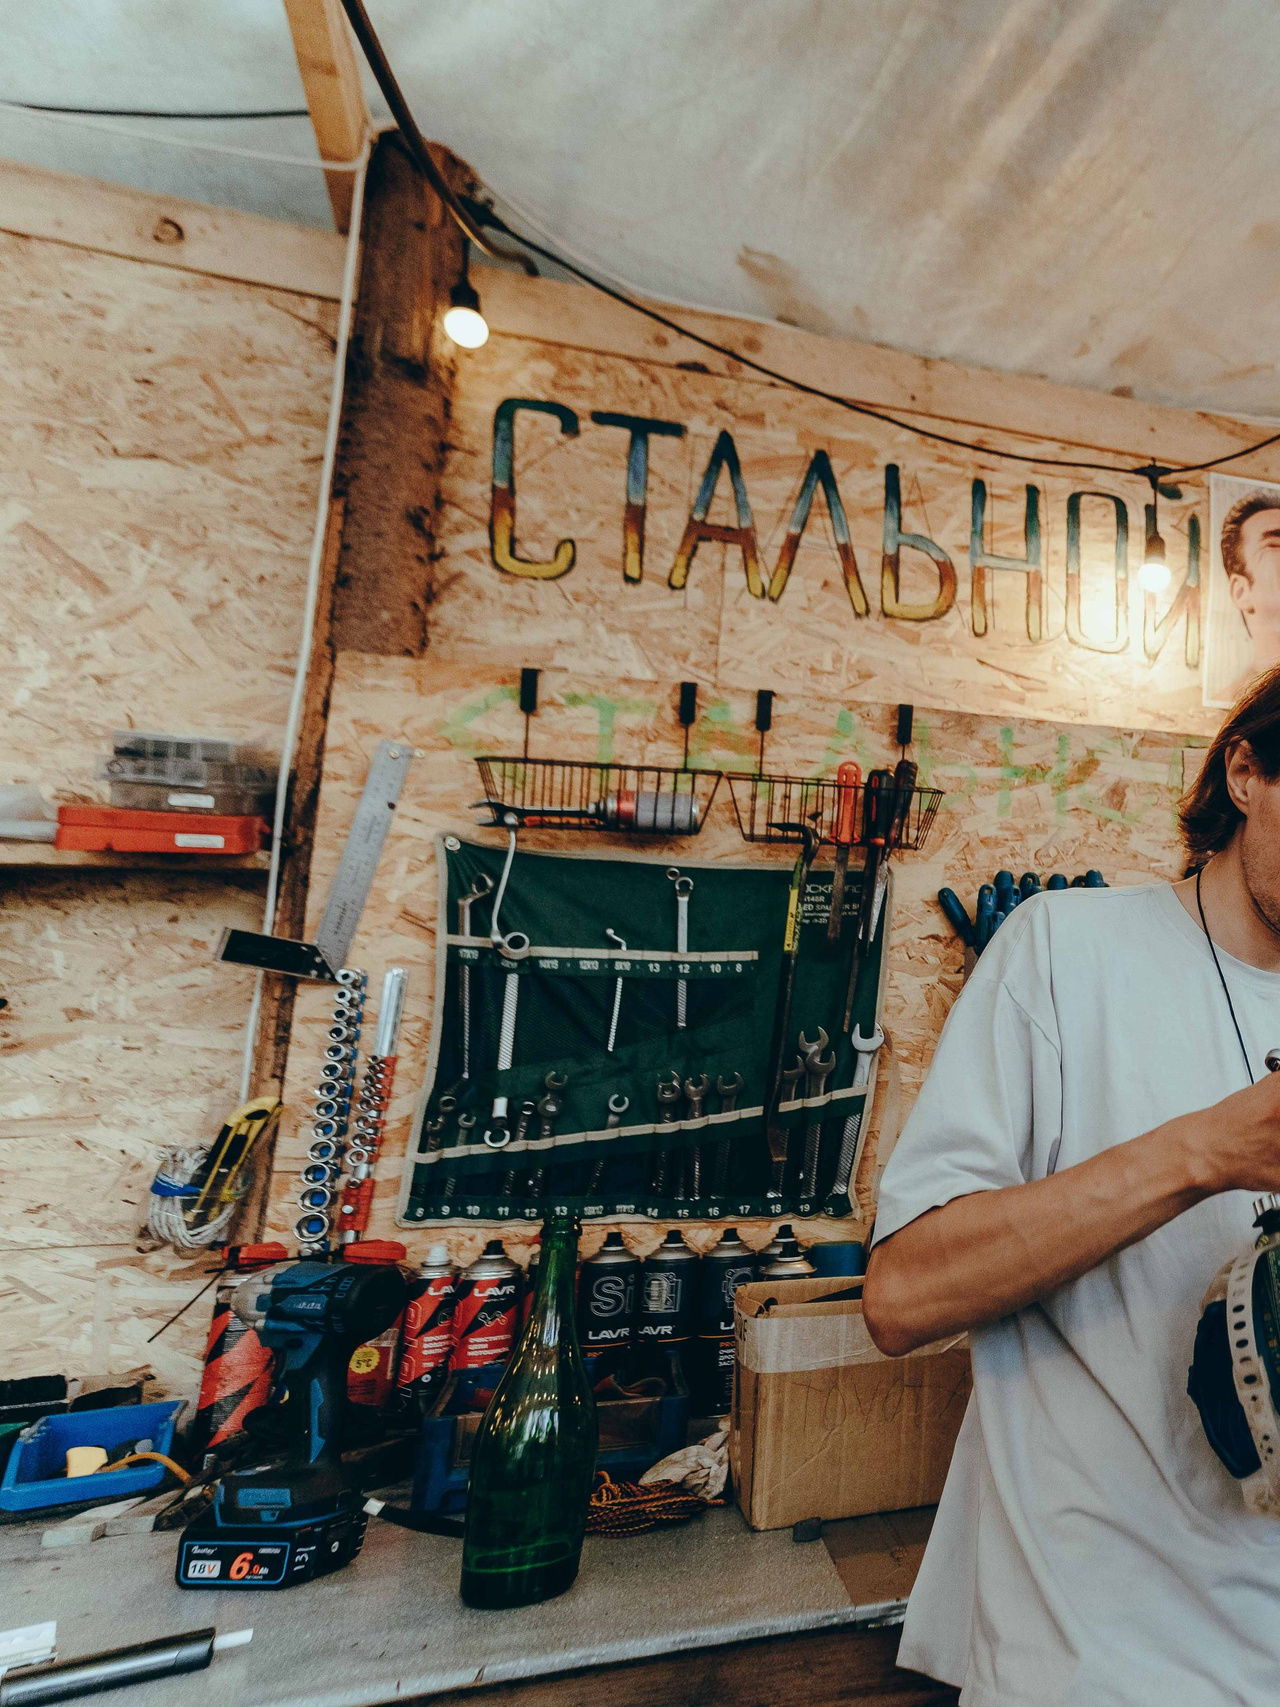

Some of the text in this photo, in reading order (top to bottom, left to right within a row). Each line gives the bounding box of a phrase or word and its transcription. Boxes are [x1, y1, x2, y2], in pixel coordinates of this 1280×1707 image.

[648, 963, 661, 973] 13
[678, 964, 690, 974] 12
[710, 963, 722, 973] 10
[441, 1205, 451, 1215] 9
[466, 1205, 480, 1216] 10
[497, 1206, 510, 1216] 11
[524, 1207, 538, 1217] 12
[554, 1206, 568, 1216] 13
[646, 1207, 659, 1217] 14
[676, 1209, 689, 1218] 15
[707, 1207, 720, 1217] 16
[738, 1205, 751, 1215] 17
[770, 1204, 782, 1214] 18
[799, 1203, 811, 1213] 19
[428, 1285, 456, 1296] LAV
[473, 1285, 516, 1297] LAVR
[588, 1327, 631, 1340] LAVR
[190, 1563, 217, 1575] 18V
